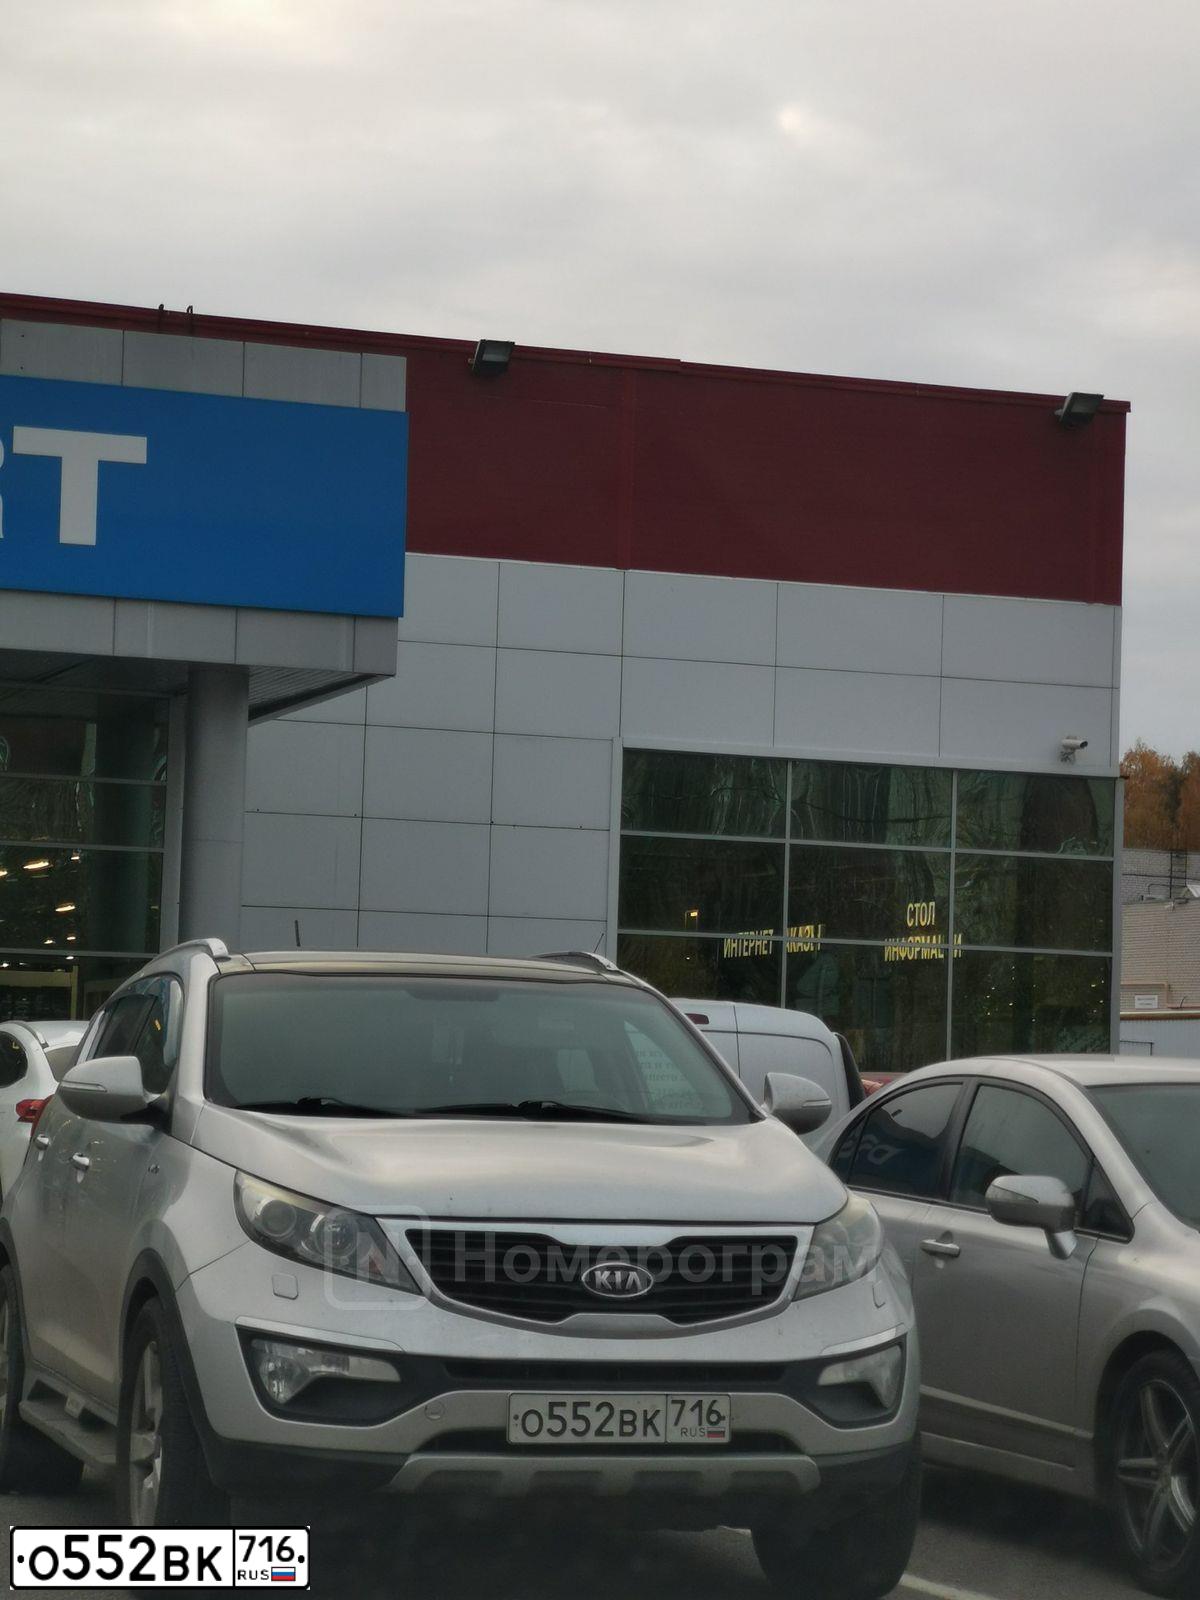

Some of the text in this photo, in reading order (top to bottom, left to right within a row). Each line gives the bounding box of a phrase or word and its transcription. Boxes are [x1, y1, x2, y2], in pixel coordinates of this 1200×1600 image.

[0, 426, 147, 545] T
[906, 901, 936, 927] СТОЛ
[723, 924, 822, 959] ИНТЕРНЕТ АКАЗЫ
[884, 932, 962, 962] ИНФОРМАЦИ
[594, 1270, 642, 1291] KIA
[521, 1400, 721, 1438] О552ВК 716
[680, 1427, 706, 1438] RUS
